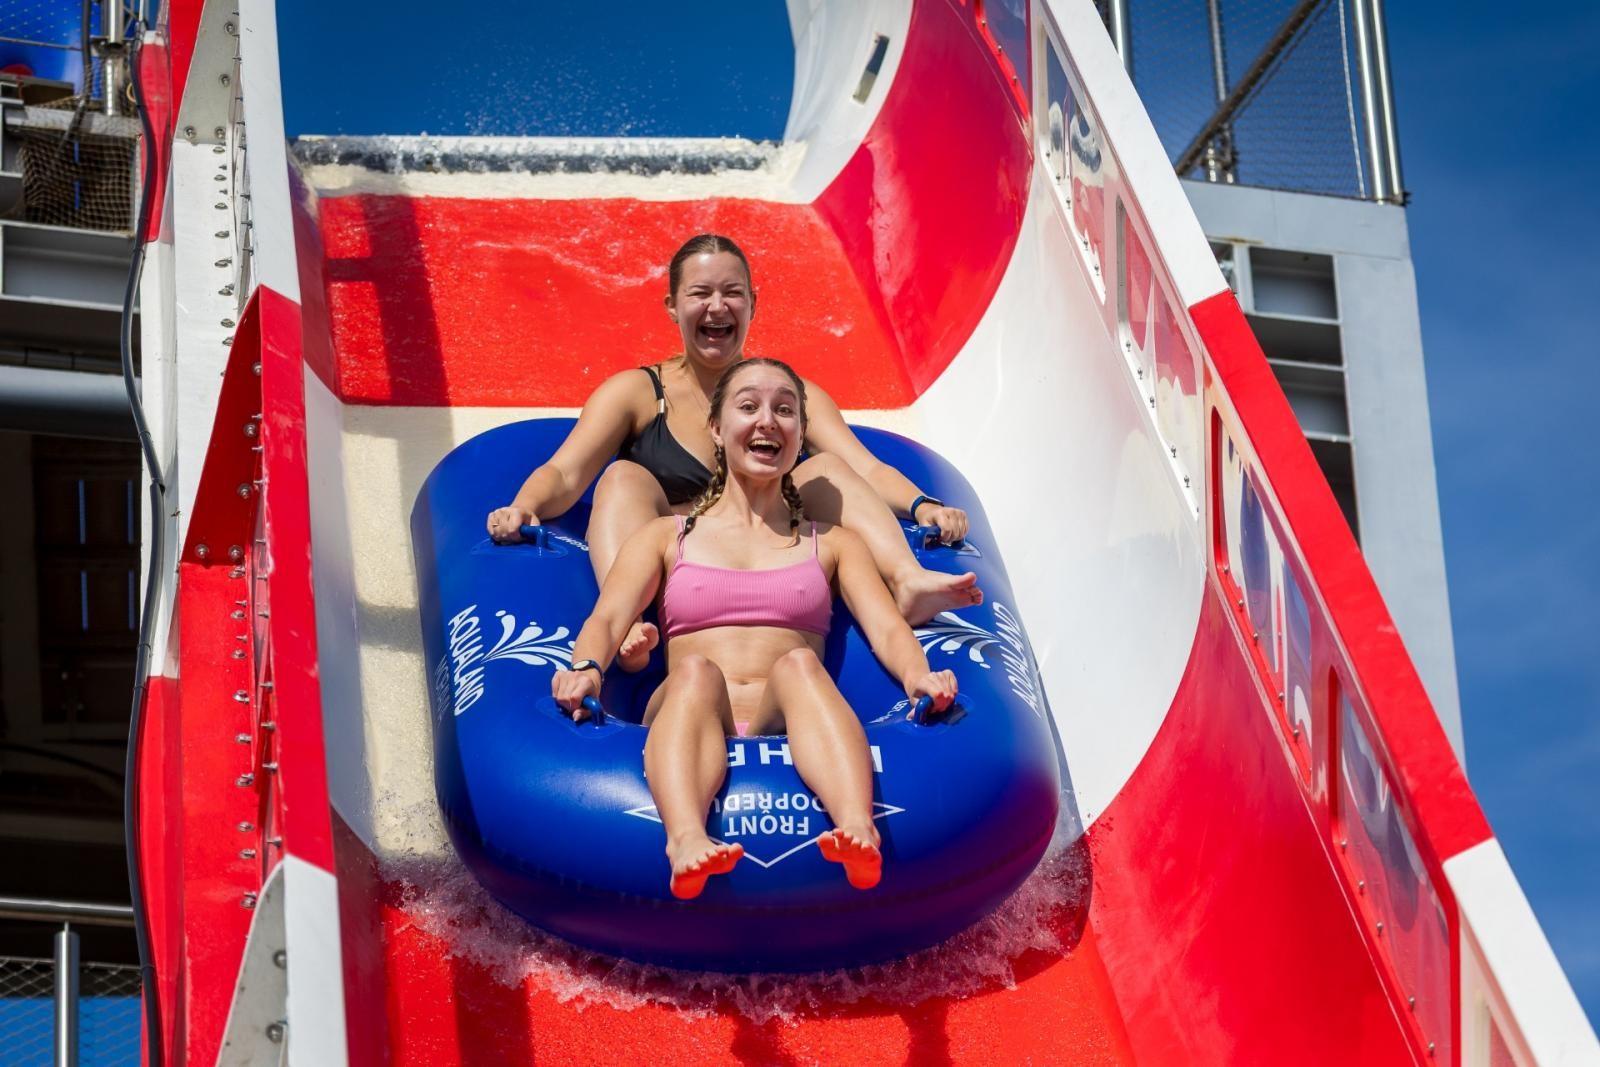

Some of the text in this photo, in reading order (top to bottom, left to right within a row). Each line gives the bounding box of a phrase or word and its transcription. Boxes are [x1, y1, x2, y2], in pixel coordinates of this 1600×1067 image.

[448, 604, 485, 716] AQUALAND
[992, 601, 1041, 718] AQUALAND
[724, 814, 809, 837] FRONT
